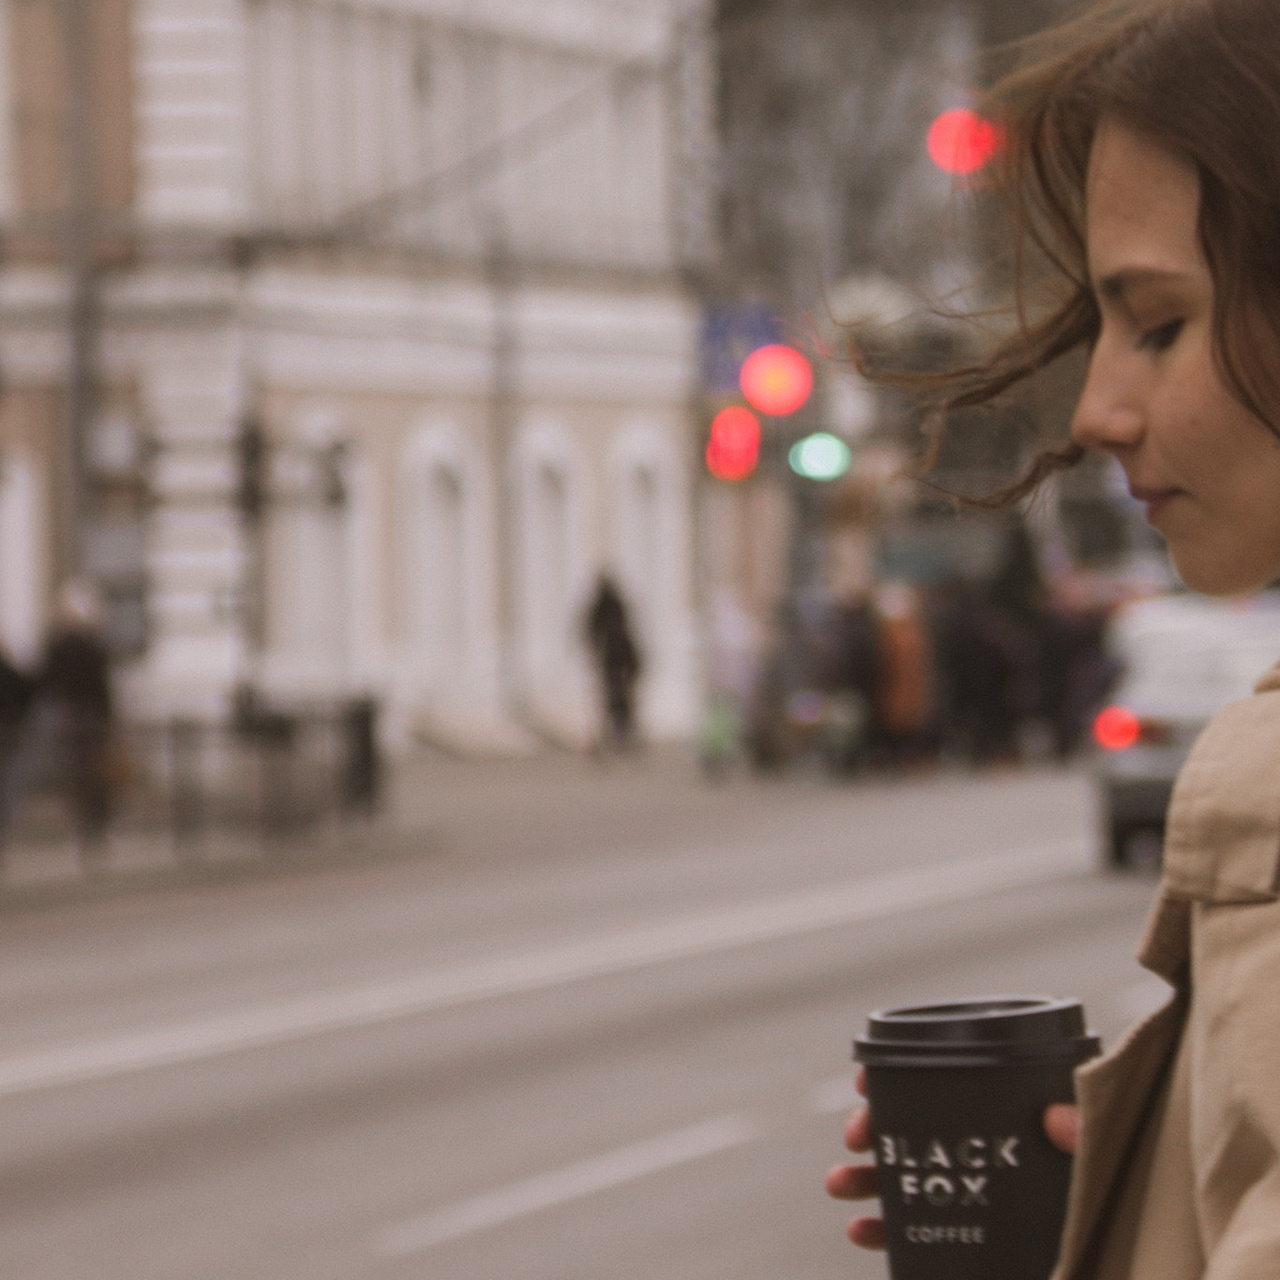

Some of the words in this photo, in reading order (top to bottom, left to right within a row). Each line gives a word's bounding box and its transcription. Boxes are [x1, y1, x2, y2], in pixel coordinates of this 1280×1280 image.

[879, 1135, 1020, 1168] BLACK
[901, 1174, 988, 1206] FOX
[906, 1226, 985, 1243] COFFEE
